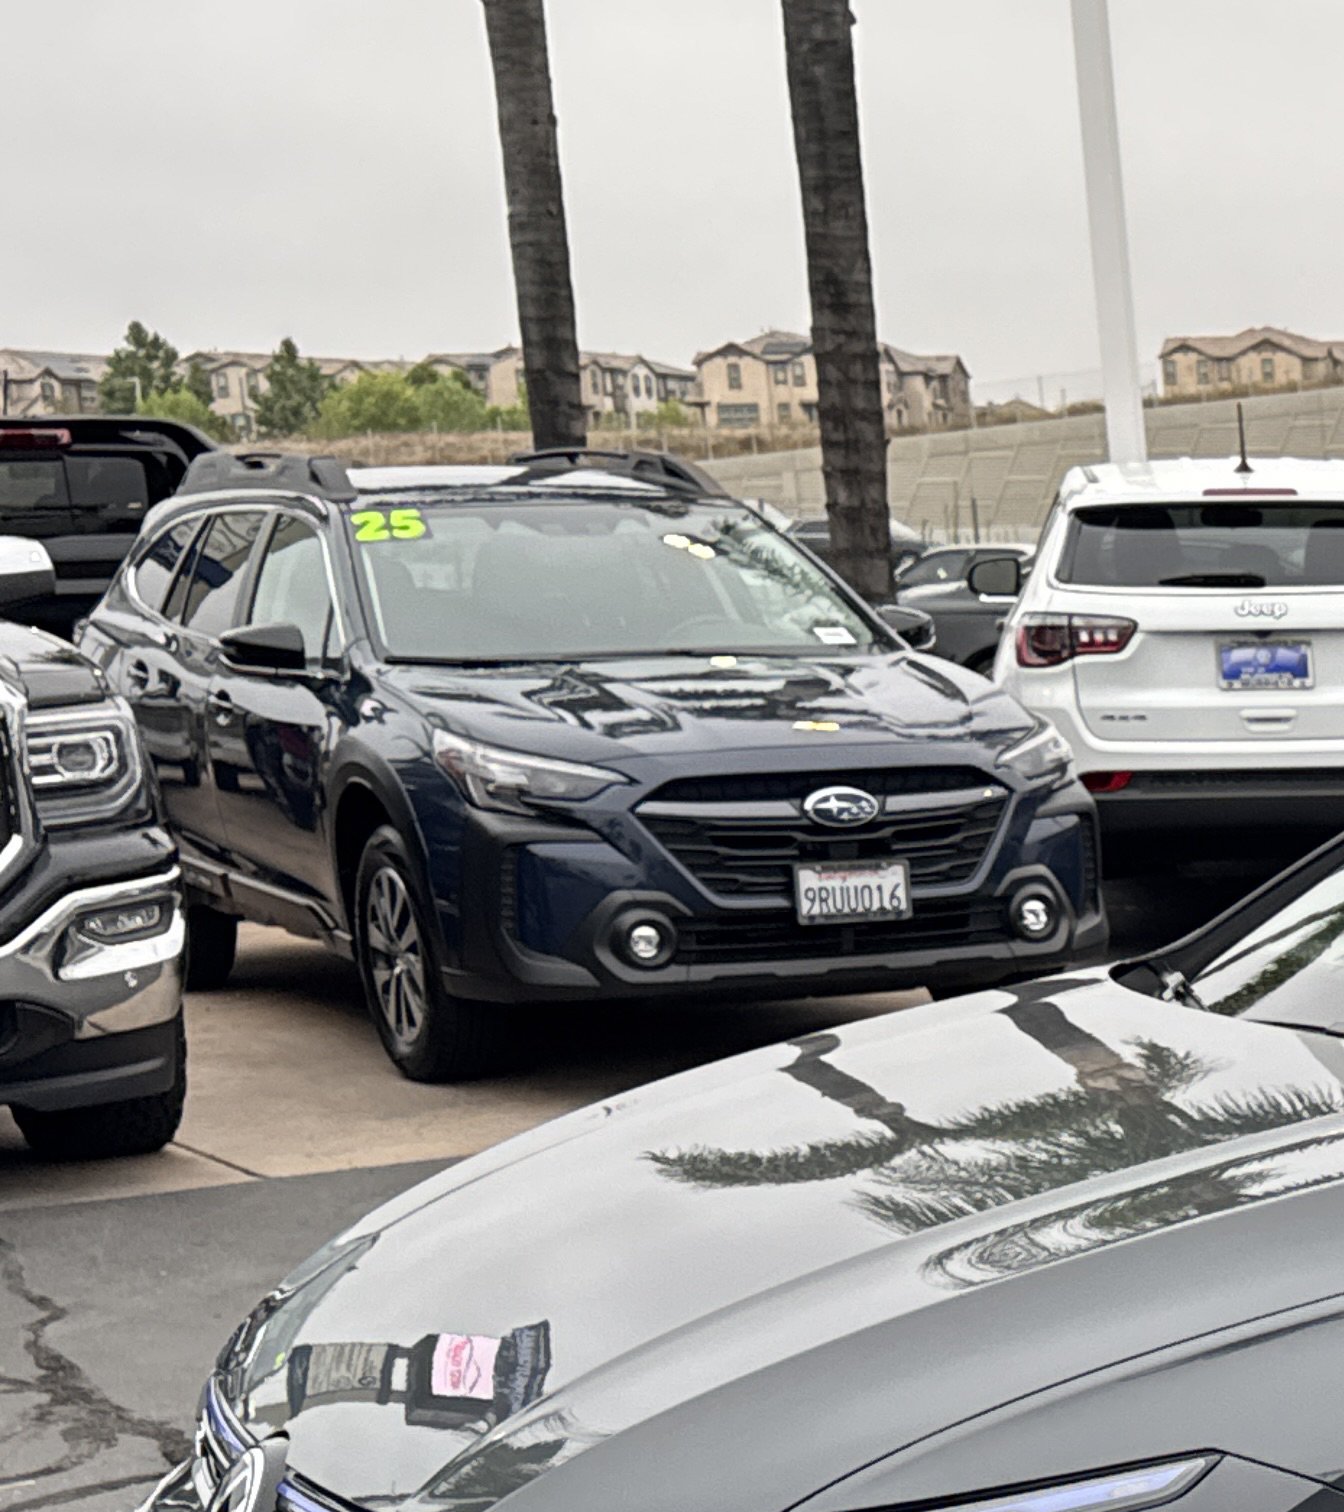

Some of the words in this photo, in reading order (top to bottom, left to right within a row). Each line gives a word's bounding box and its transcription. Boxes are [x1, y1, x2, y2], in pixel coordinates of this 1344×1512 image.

[350, 508, 426, 541] 25
[1235, 599, 1288, 619] Jeep
[804, 883, 902, 914] 9RUU016
